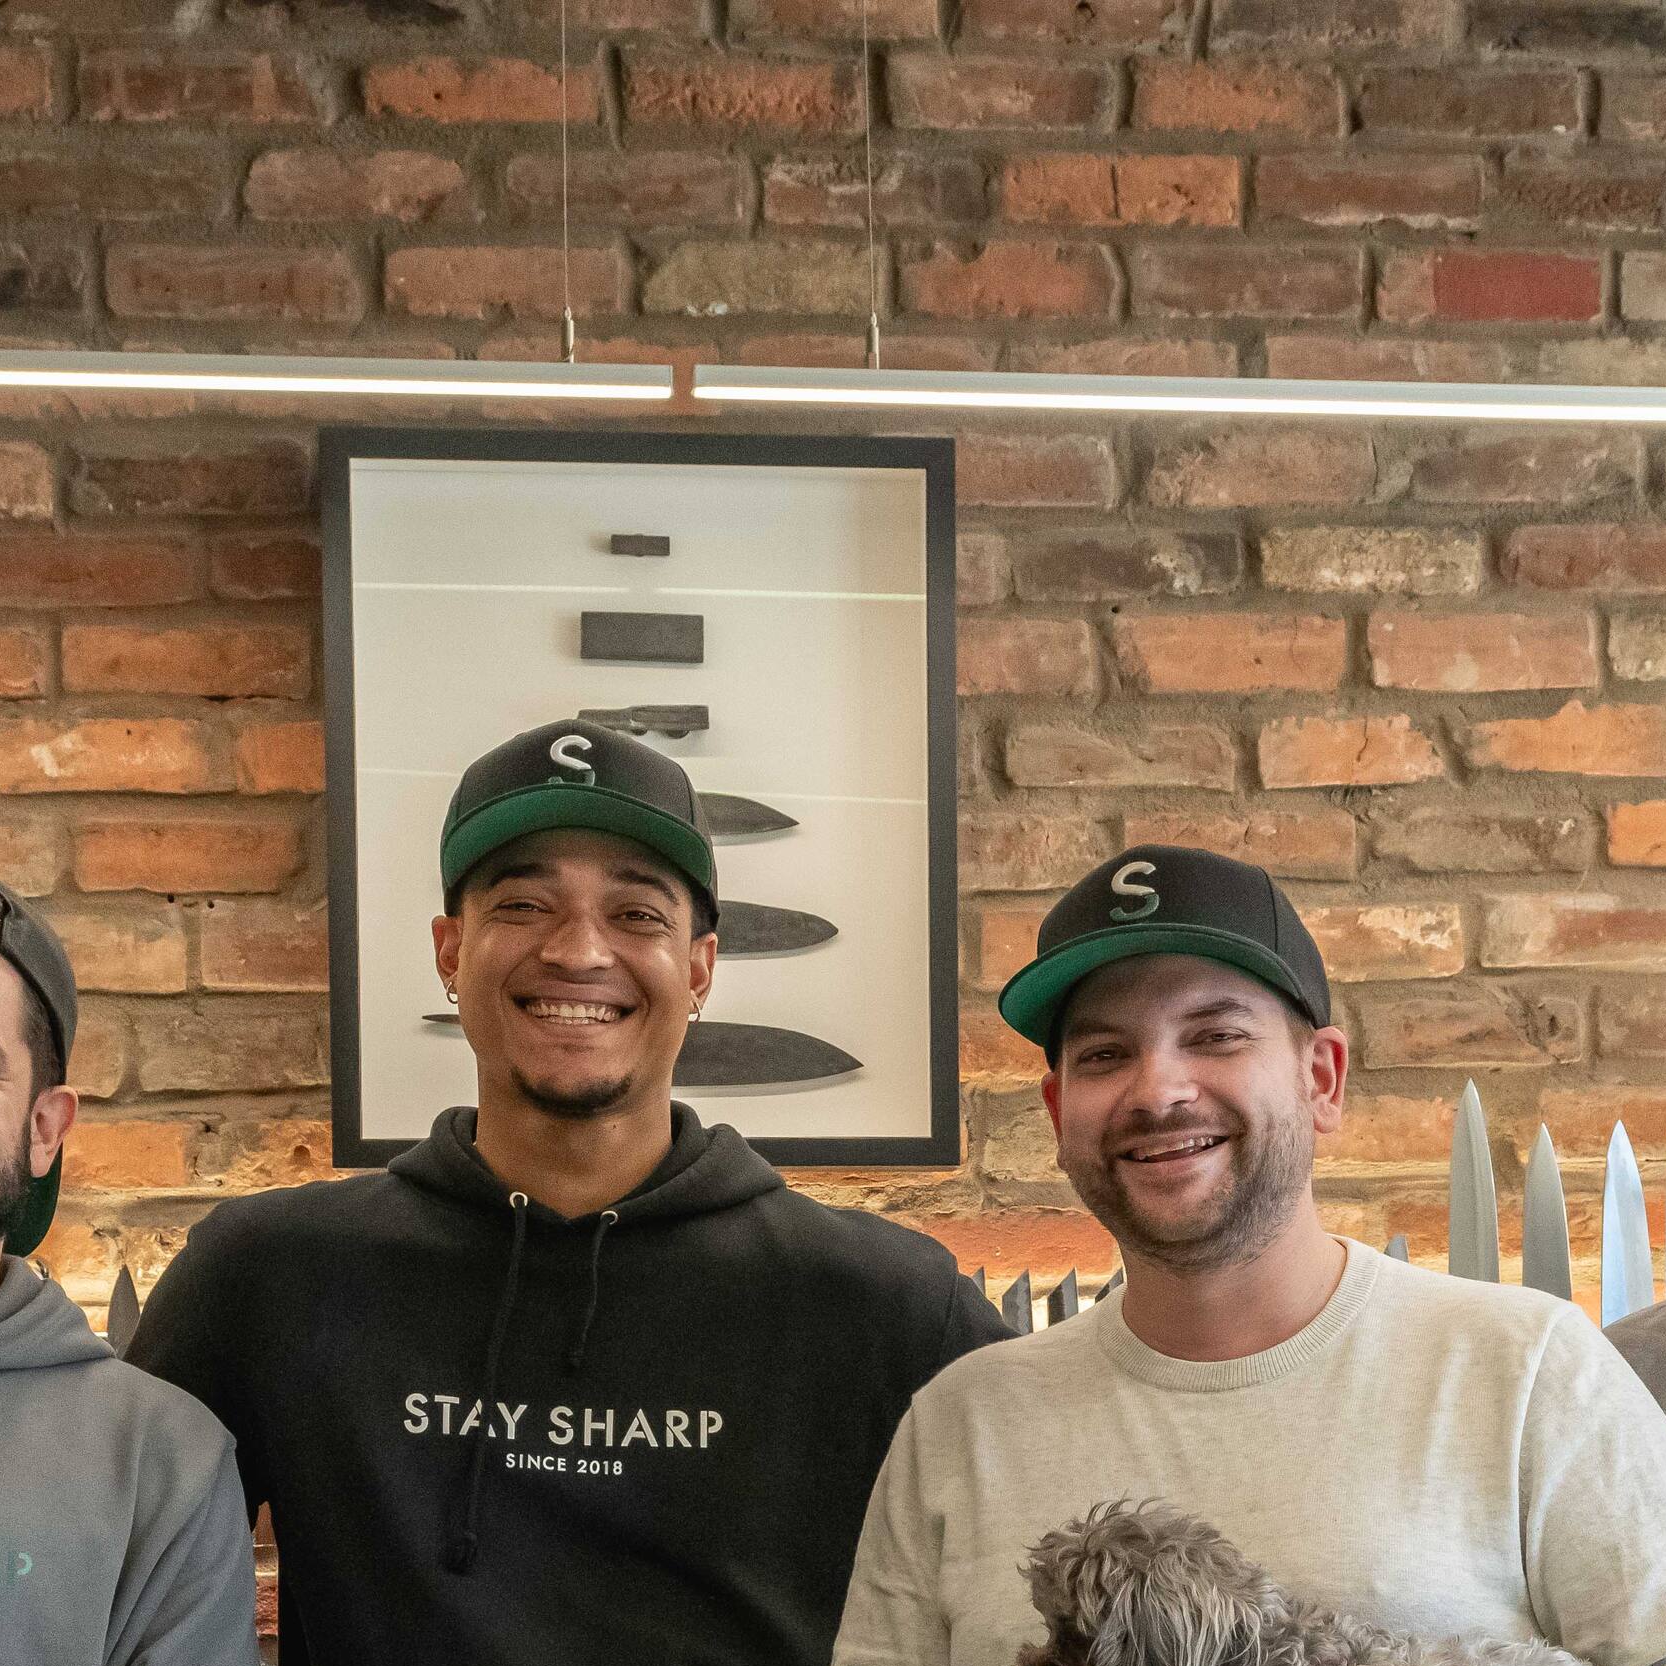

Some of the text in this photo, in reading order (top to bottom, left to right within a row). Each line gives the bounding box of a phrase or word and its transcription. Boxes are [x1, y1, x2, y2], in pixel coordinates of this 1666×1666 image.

[548, 735, 596, 786] S
[1110, 861, 1160, 921] S
[403, 1393, 723, 1448] STAY SHARP
[505, 1453, 623, 1476] SINCE 2018
